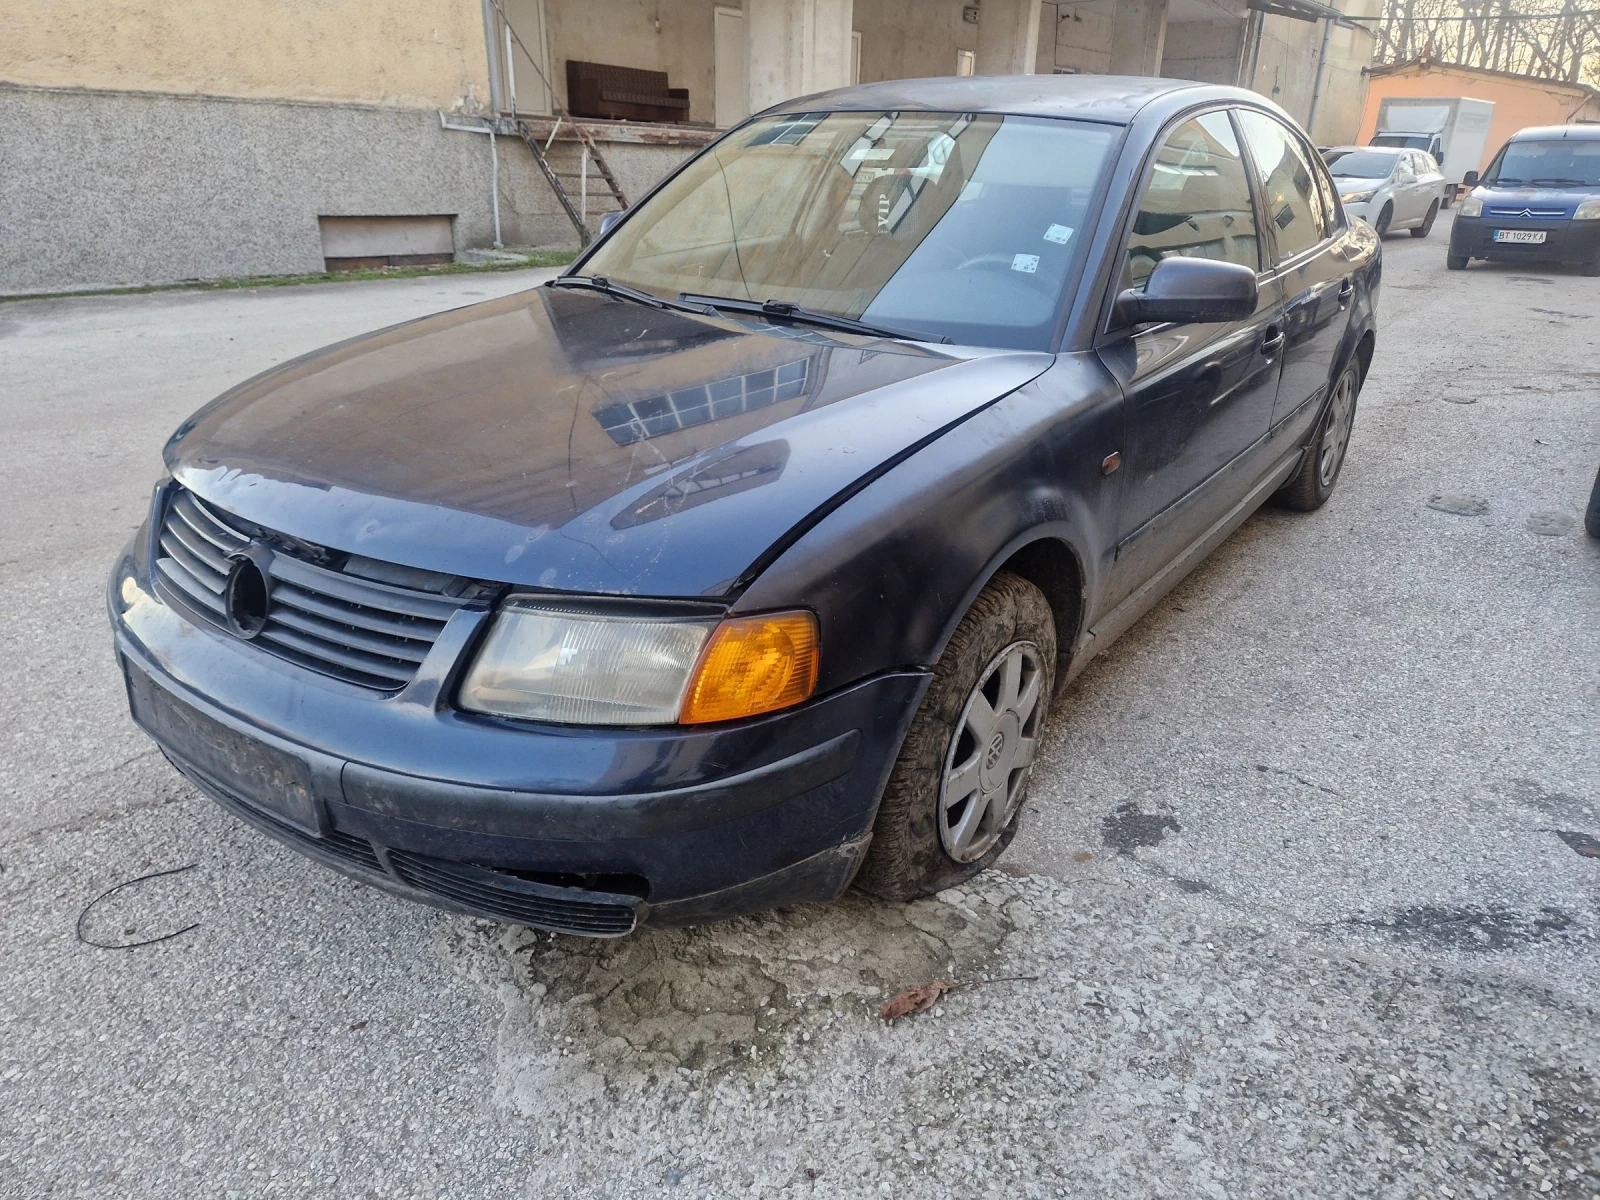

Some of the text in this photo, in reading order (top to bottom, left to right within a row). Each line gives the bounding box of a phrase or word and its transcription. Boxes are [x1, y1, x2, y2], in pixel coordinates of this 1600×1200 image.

[1499, 231, 1544, 241] BT 1029 KA
